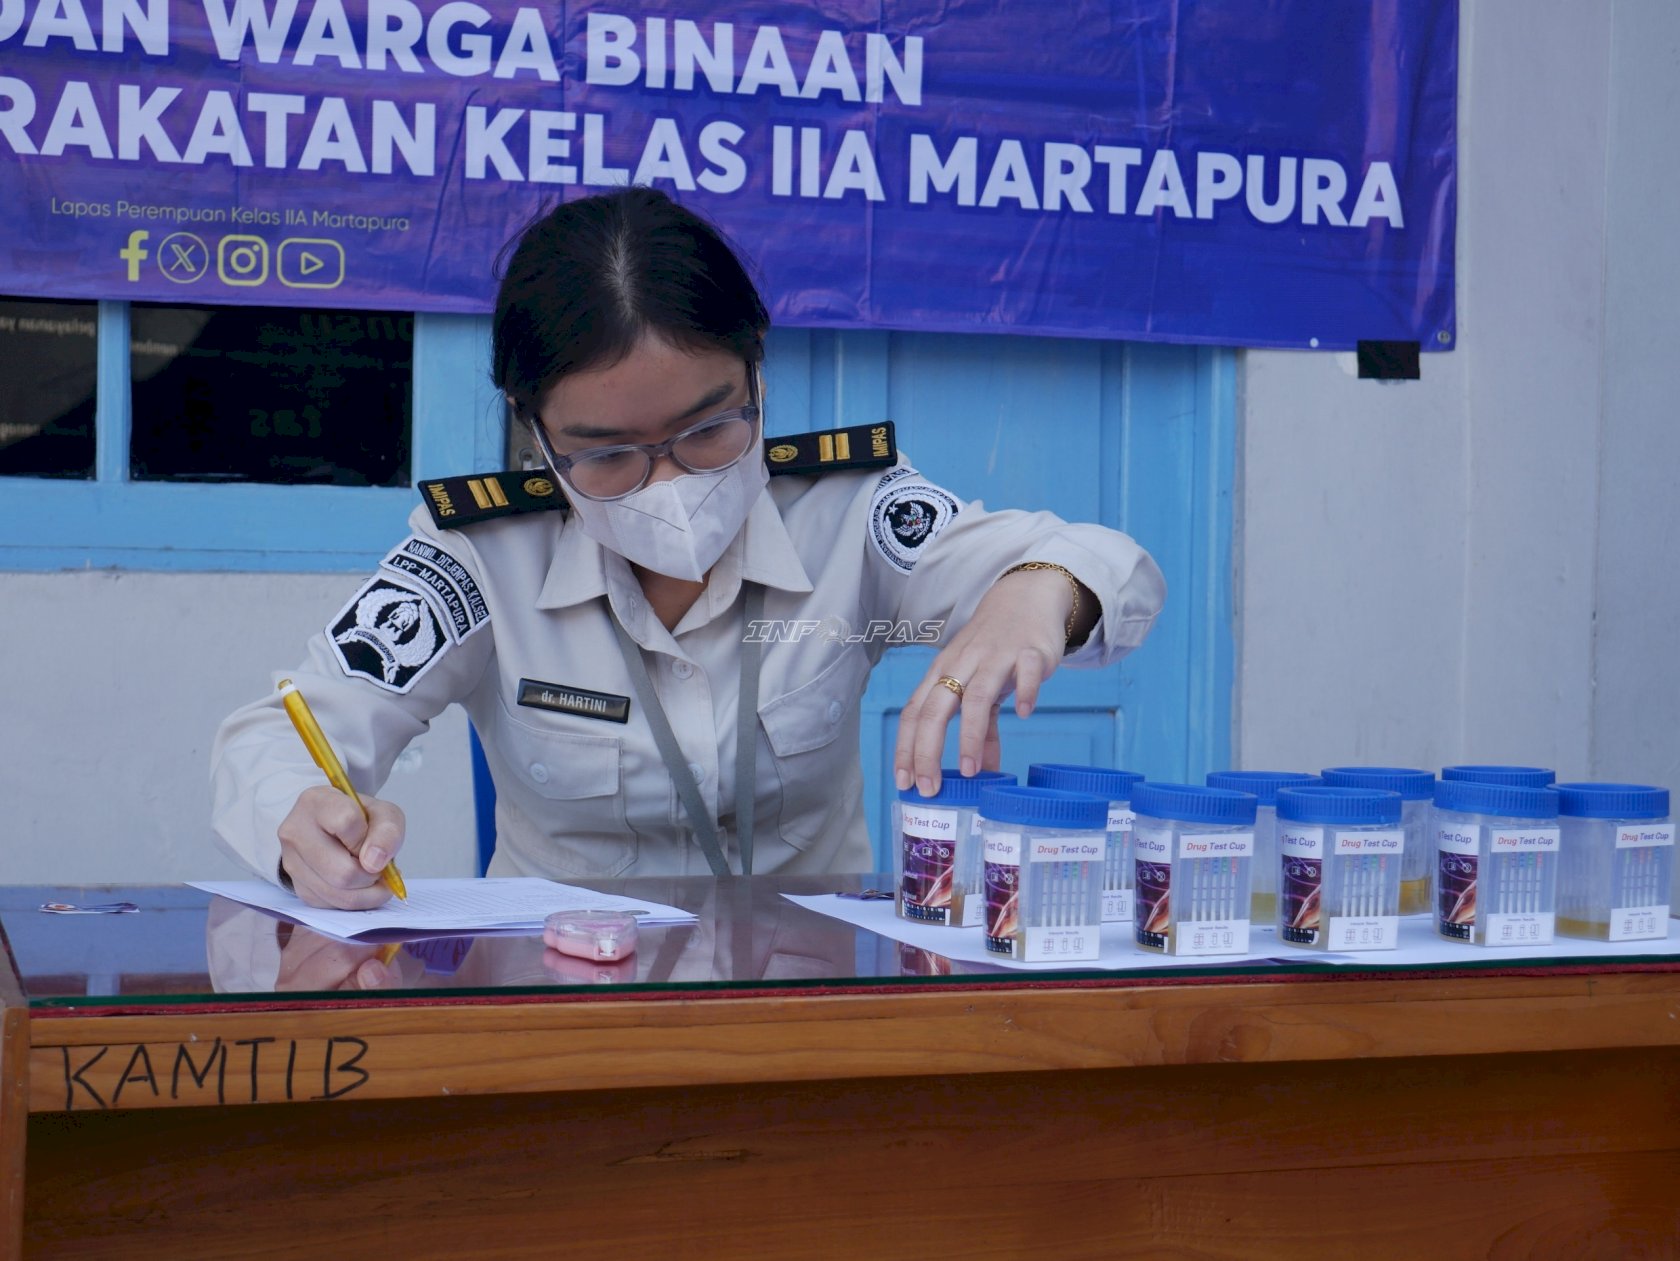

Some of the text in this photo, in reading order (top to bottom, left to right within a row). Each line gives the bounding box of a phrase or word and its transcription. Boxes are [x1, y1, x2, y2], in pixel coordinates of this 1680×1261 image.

[0, 0, 923, 106] AN WARGA BINAAN
[0, 76, 1404, 229] RAKATAN KELAS IIA MARTAPURA
[51, 197, 111, 219] Lapas
[117, 200, 226, 224] Perempuan
[231, 207, 281, 226] Kelas
[312, 211, 410, 232] Martapura
[871, 427, 889, 457] IMIPAS
[427, 483, 456, 517] IMIPAS
[407, 541, 438, 562] KANWIL
[419, 568, 468, 632] MARTAPURA
[559, 692, 607, 713] HARTINI
[914, 817, 929, 827] Test
[932, 819, 950, 831] Cup
[1298, 837, 1316, 849] Cup
[1341, 839, 1398, 849] Drug Test Cup
[1455, 833, 1472, 844] Cup
[1497, 836, 1554, 847] Drug Test Cup
[1622, 832, 1669, 843] Drug Test Cup
[996, 842, 1014, 853] Cup
[1037, 844, 1098, 855] Drug Test Cup
[1149, 840, 1166, 852] Cup
[1186, 841, 1246, 851] Drug Test Cup
[61, 1036, 370, 1110] KAMTIB
